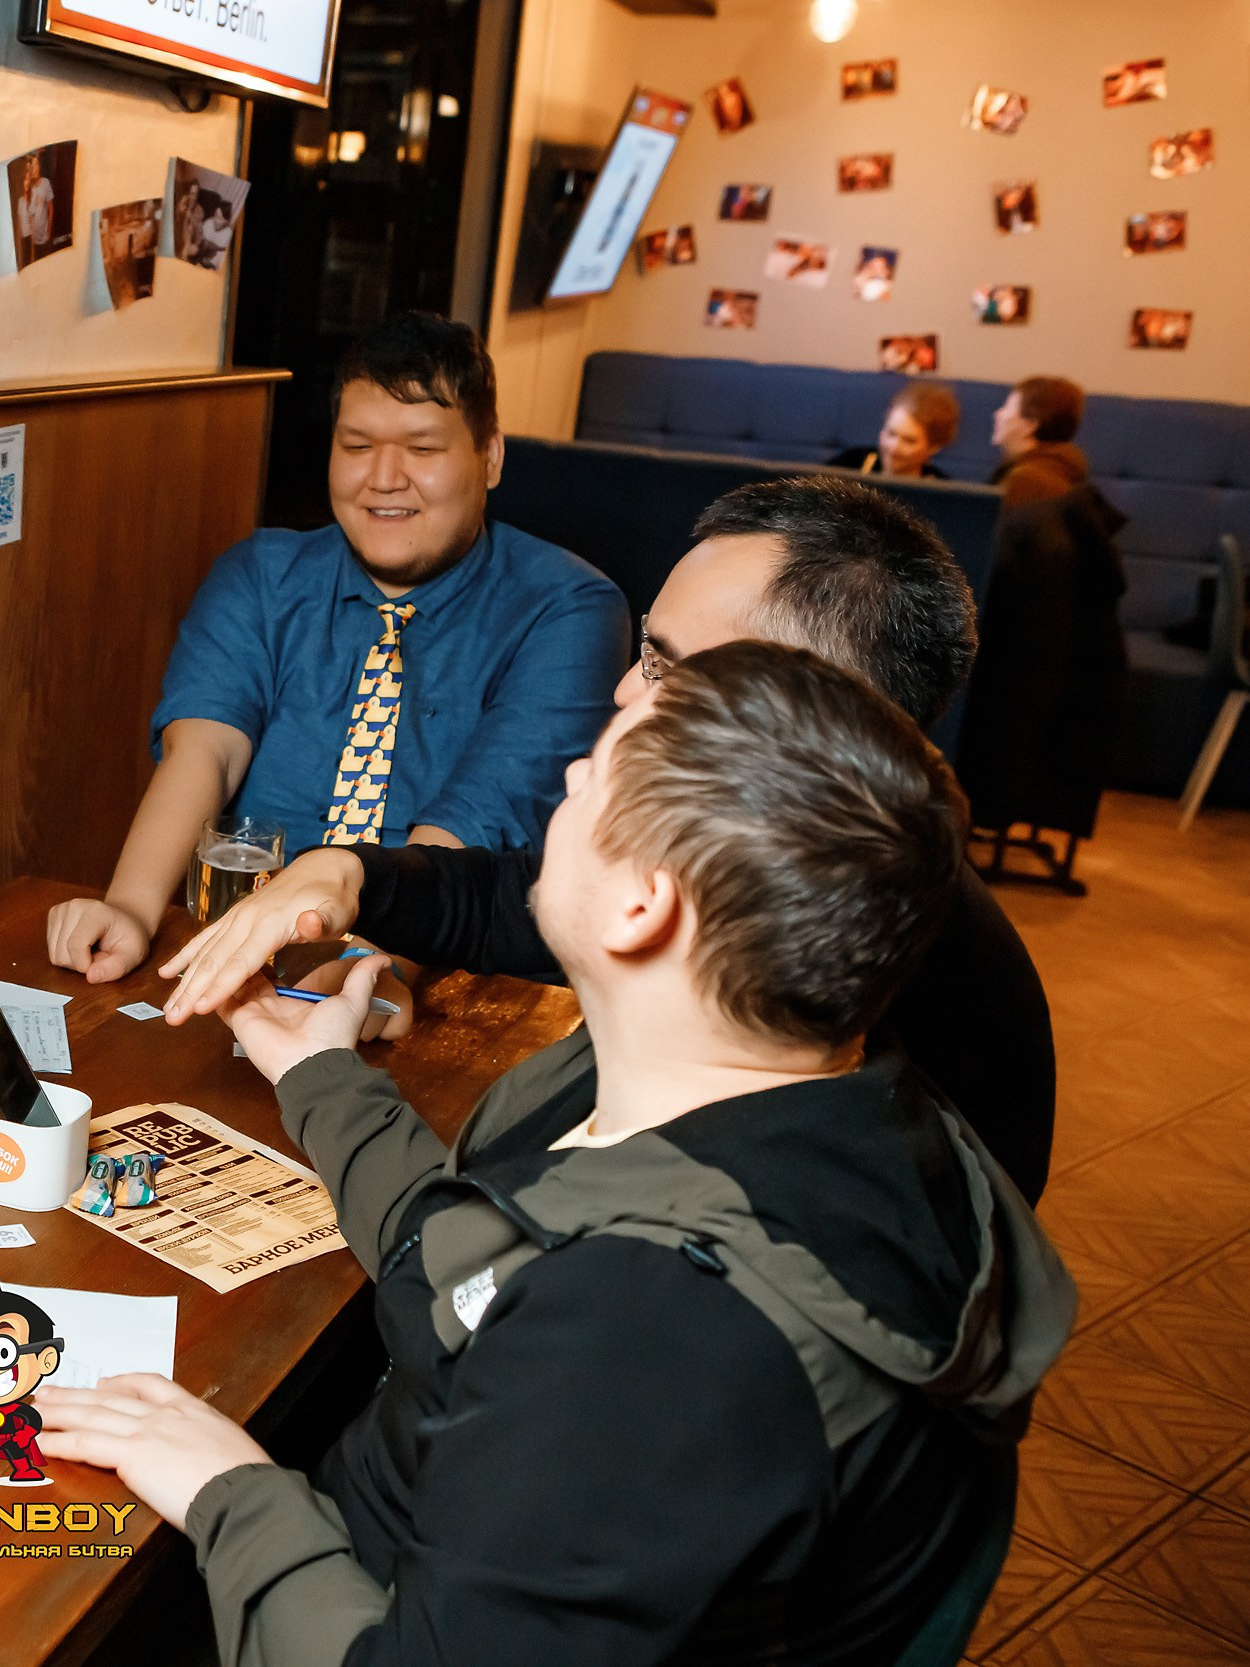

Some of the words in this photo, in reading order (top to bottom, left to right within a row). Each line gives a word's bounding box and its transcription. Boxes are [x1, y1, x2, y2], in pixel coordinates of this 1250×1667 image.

[217, 0, 267, 42] Berlin.
[122, 1121, 164, 1138] RE
[138, 1124, 193, 1146] PUB
[154, 1135, 201, 1154] LIC
[222, 1240, 304, 1274] БАРНОЕ
[298, 1223, 339, 1244] МЕН
